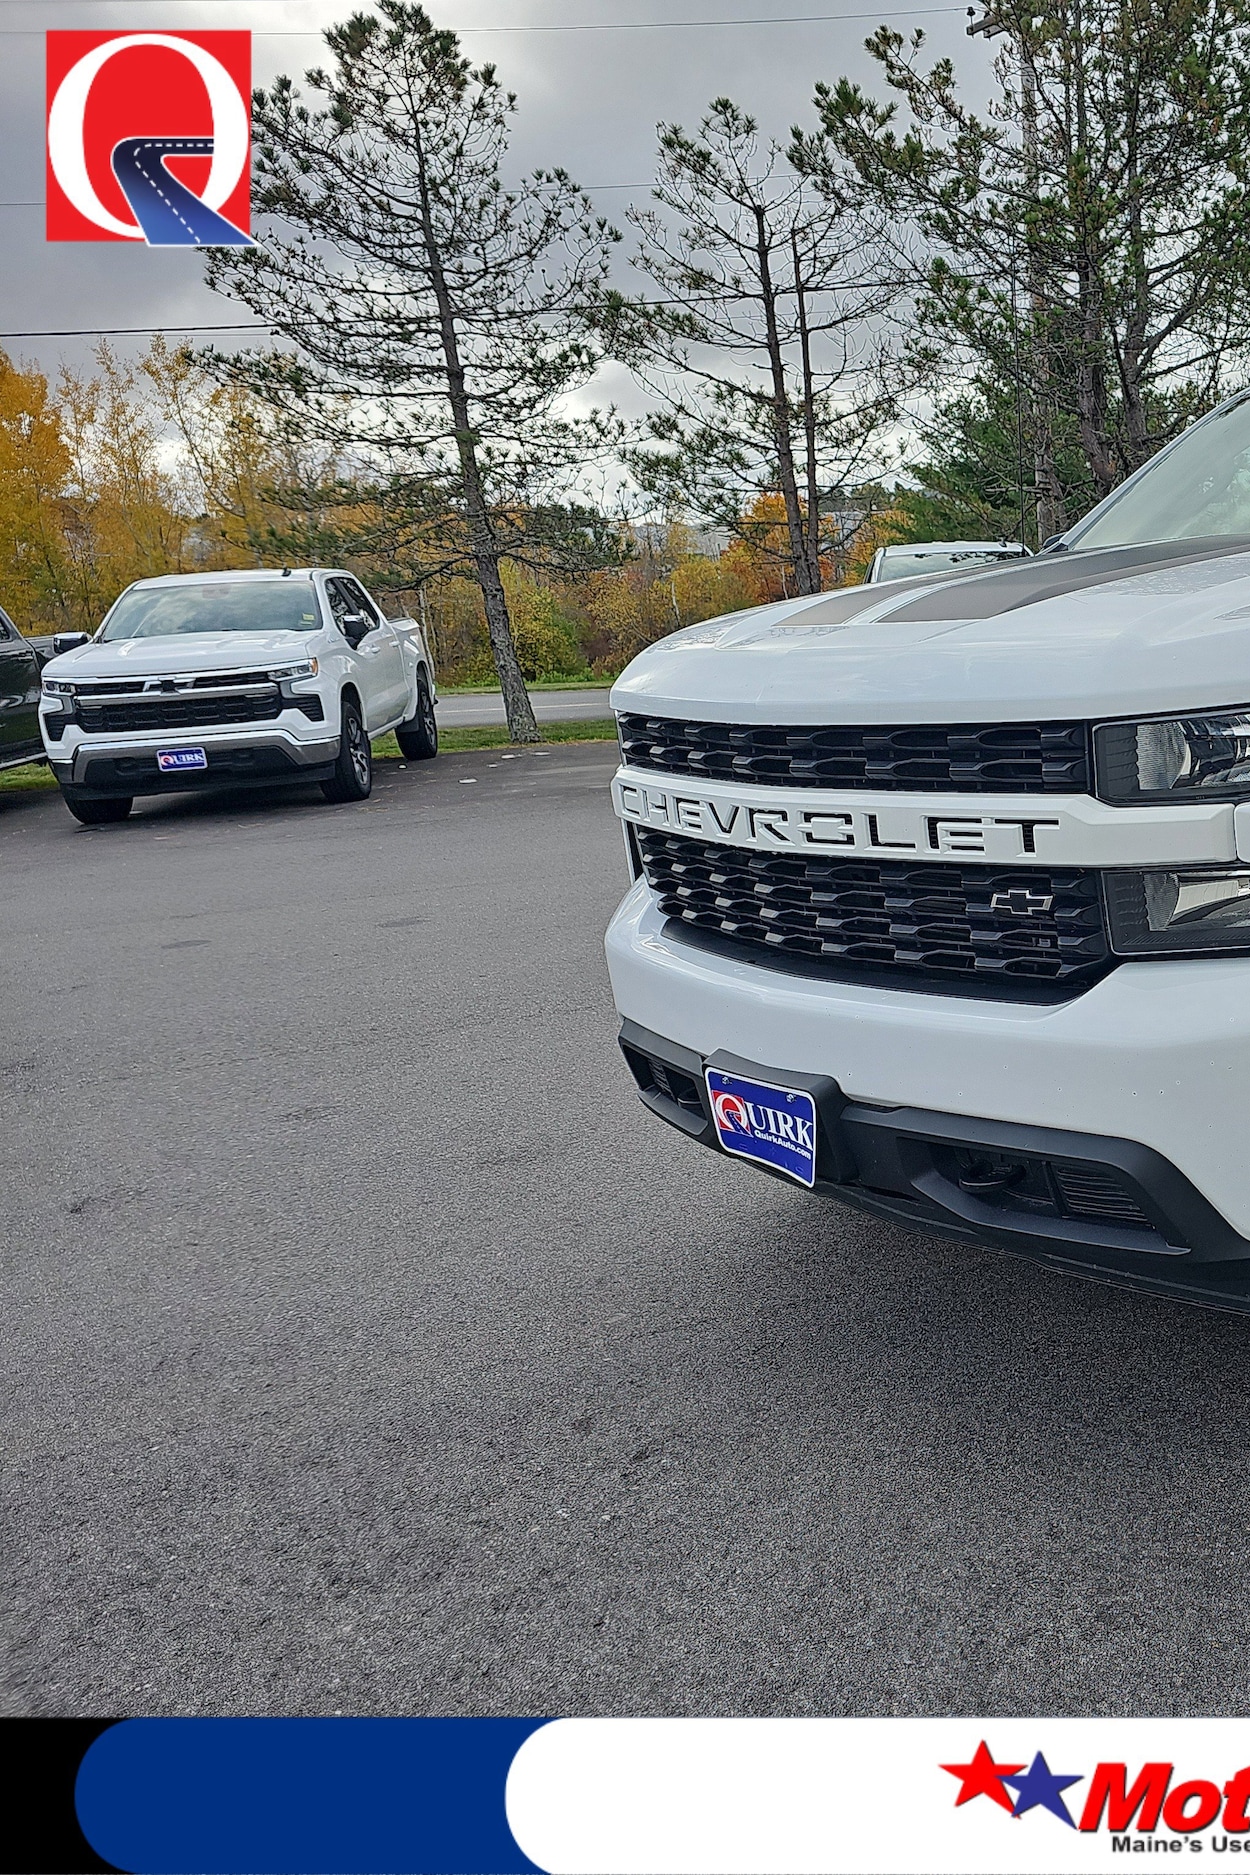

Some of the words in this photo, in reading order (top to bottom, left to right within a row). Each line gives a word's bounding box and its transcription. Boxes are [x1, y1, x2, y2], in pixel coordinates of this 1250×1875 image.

[160, 753, 204, 766] QUIRK
[618, 782, 1060, 858] CHEVROLET
[715, 1093, 814, 1151] QUIRK
[754, 1129, 812, 1160] QuirkAuto.com
